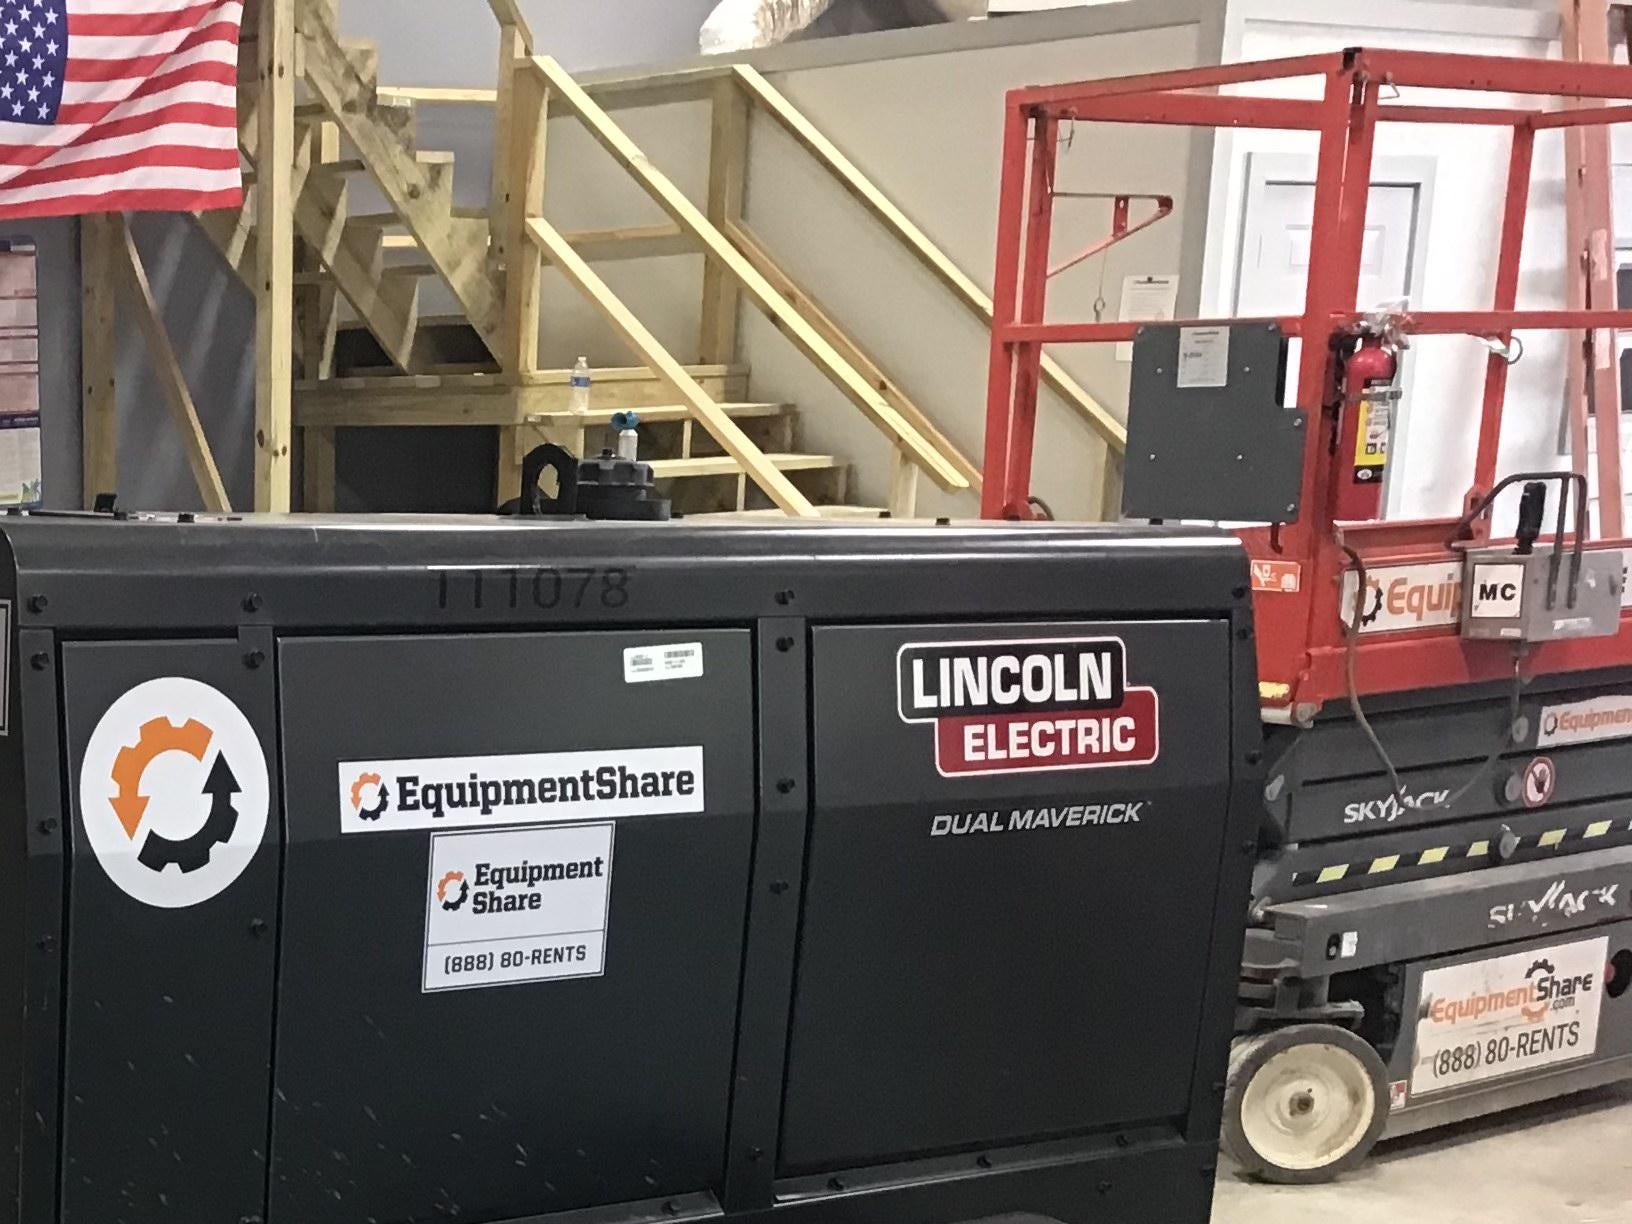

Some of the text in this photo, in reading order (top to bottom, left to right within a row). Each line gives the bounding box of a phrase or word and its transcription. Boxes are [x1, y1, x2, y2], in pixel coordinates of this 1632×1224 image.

[1478, 583, 1517, 601] MC
[912, 652, 1112, 708] LINCOLN
[964, 717, 1136, 761] ELECTRIC
[396, 765, 695, 818] EquipmentShare
[930, 802, 1143, 837] DUAL MAVERICK
[473, 856, 604, 890] Equipment
[472, 891, 542, 915] Share
[444, 945, 588, 976] (888) 80-RENTS
[1432, 1020, 1581, 1078] (888) 80-RENTS
